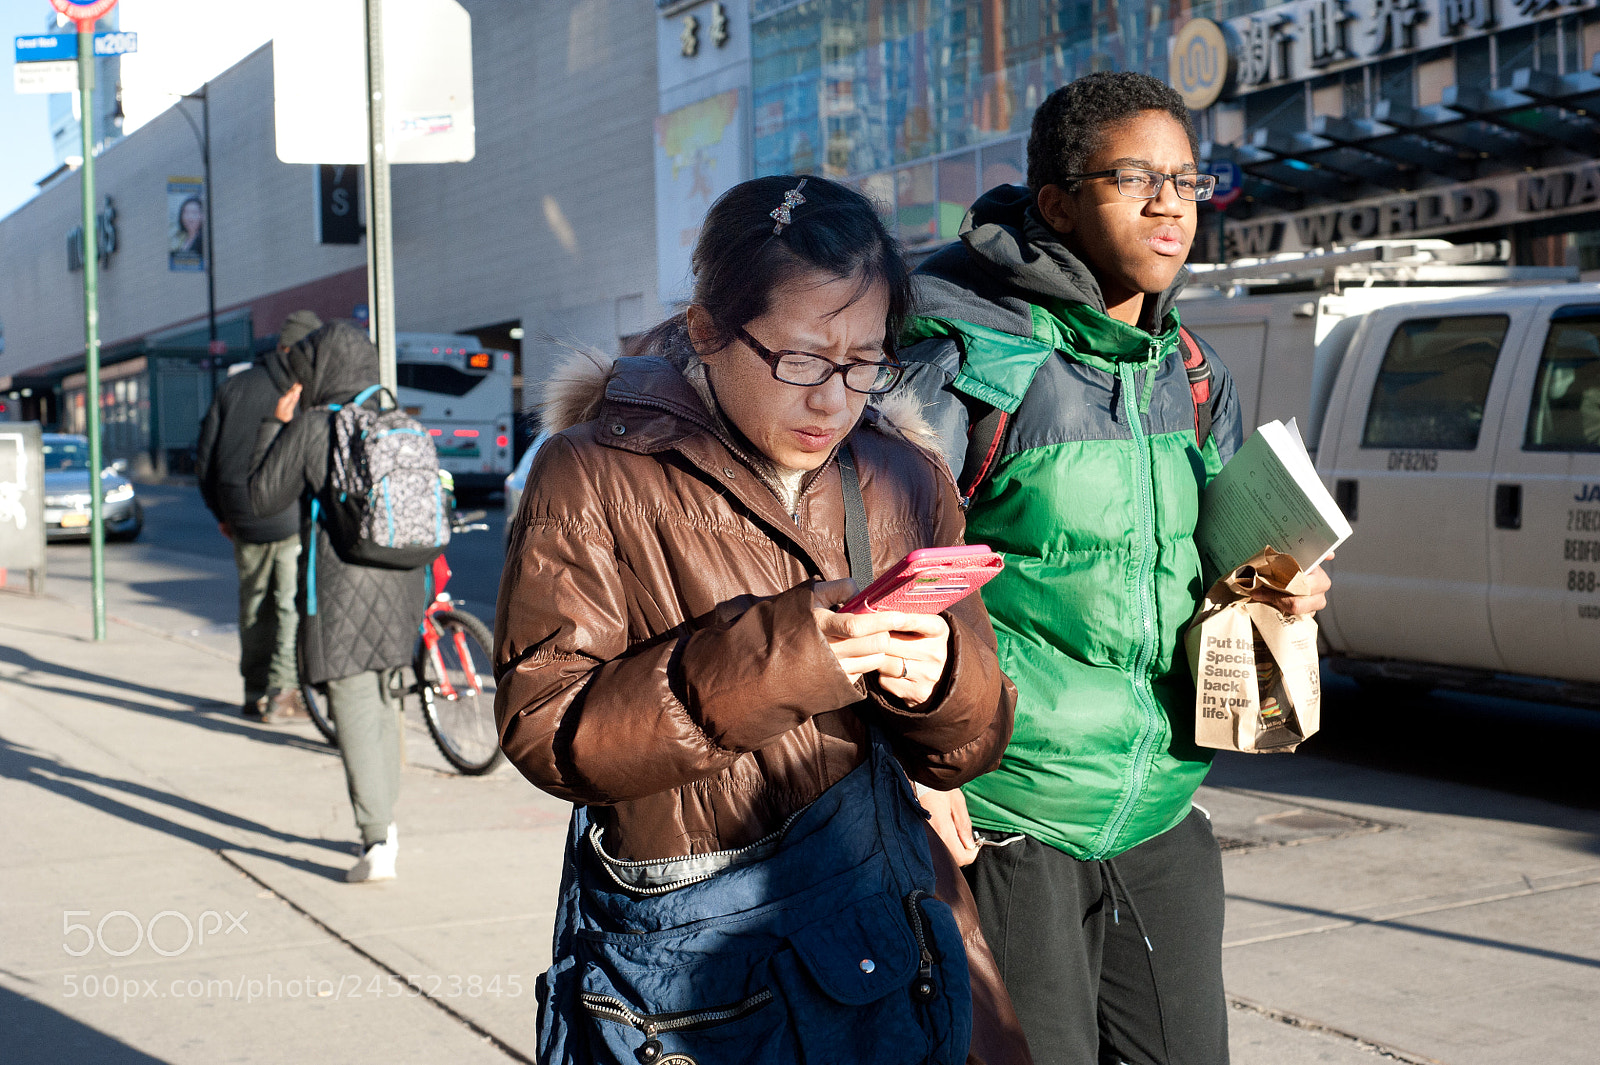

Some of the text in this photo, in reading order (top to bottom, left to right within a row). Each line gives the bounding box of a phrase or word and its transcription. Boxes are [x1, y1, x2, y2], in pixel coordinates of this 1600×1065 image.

[1296, 187, 1496, 247] WORLD
[1206, 635, 1232, 649] Put
[1205, 650, 1254, 665] Specia
[1204, 665, 1250, 679] Sauce
[1203, 679, 1240, 692] back
[1202, 693, 1252, 708] in your
[1202, 708, 1229, 720] life.
